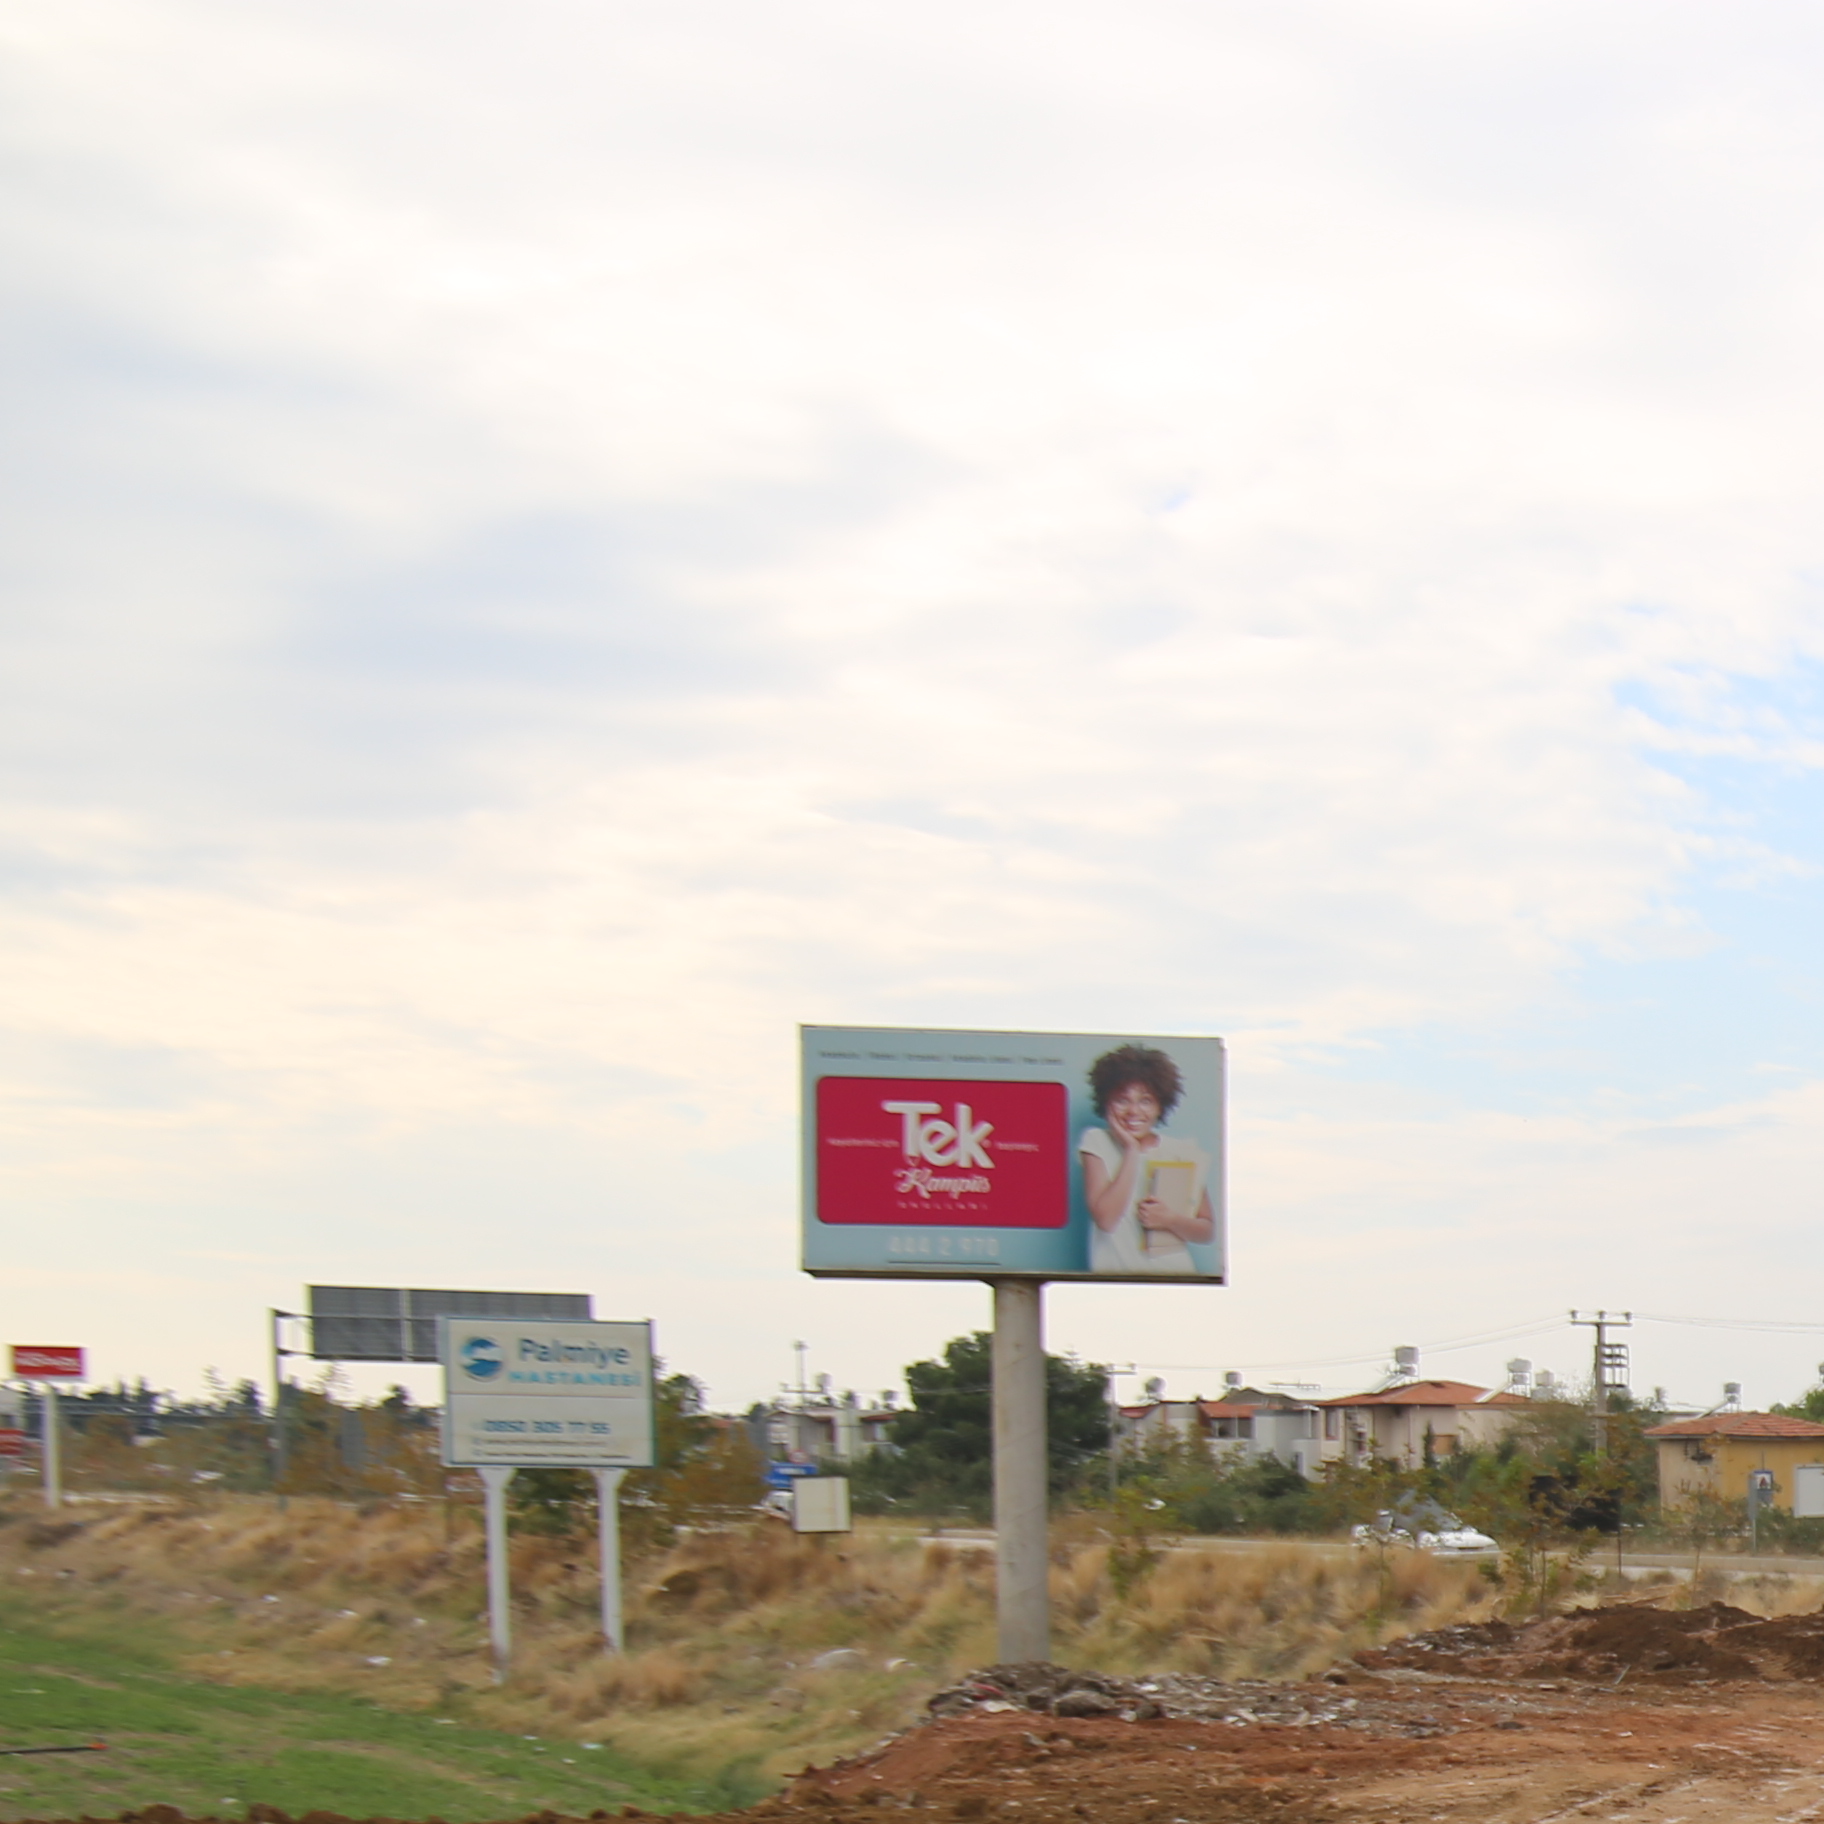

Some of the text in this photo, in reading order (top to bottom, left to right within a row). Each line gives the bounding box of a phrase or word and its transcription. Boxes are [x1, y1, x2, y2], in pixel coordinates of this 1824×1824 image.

[880, 1099, 996, 1169] Tek
[893, 1167, 992, 1200] Kampüs
[888, 1236, 931, 1256] 444
[938, 1236, 952, 1257] 2
[519, 1337, 631, 1369] Palmiye
